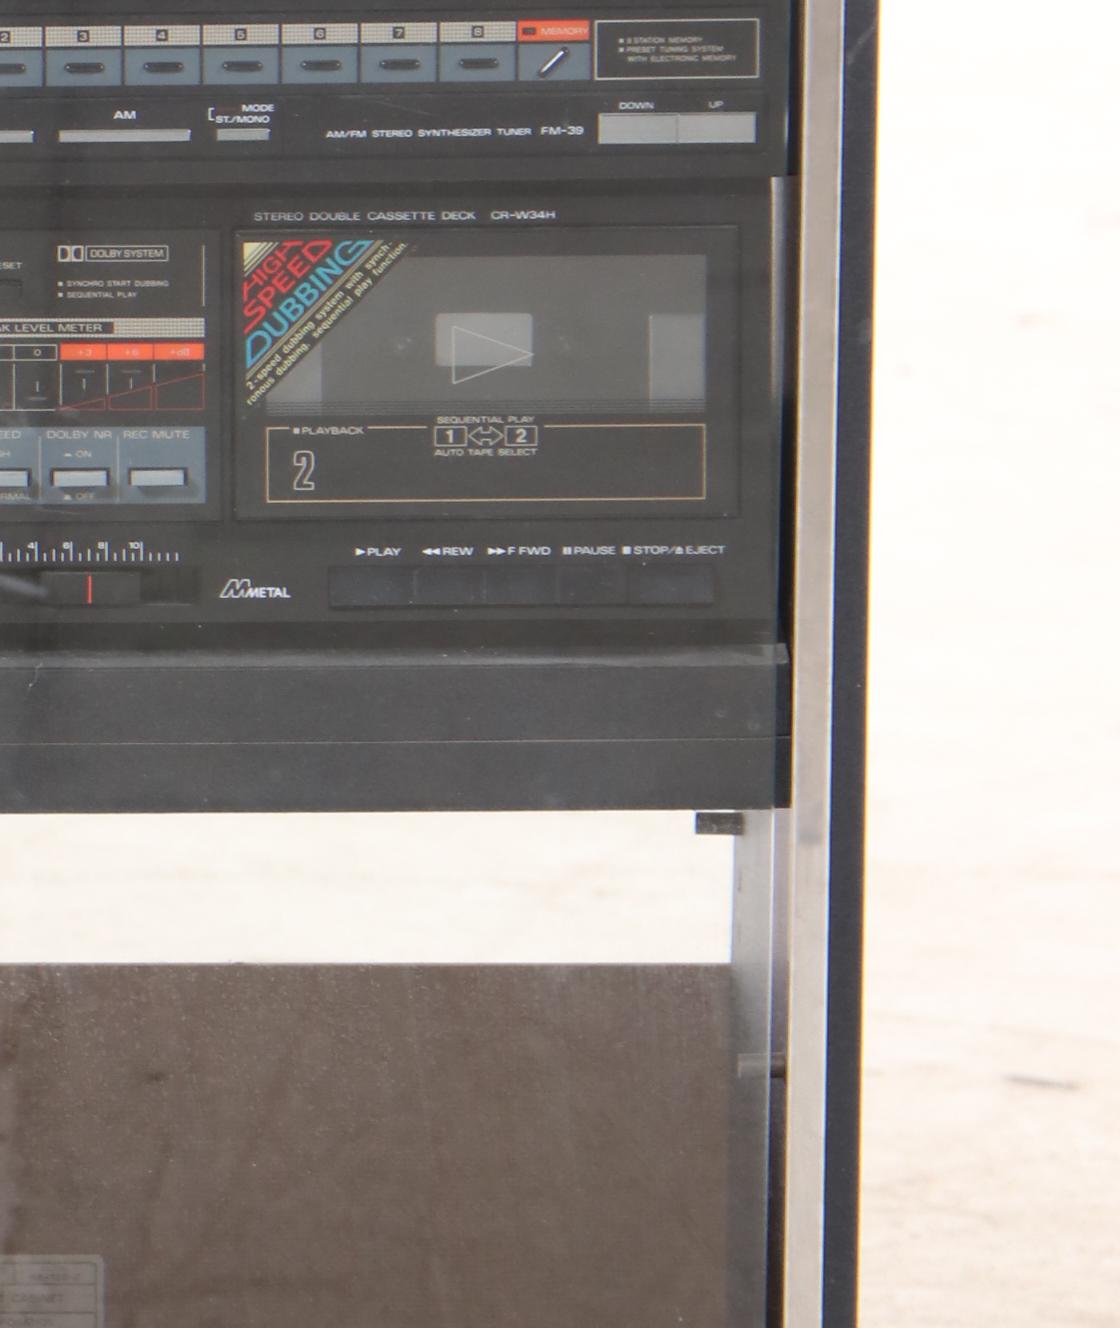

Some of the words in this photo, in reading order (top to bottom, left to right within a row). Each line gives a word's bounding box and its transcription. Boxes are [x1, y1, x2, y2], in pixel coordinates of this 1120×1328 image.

[80, 32, 87, 41] 3
[158, 31, 166, 40] 4
[237, 31, 245, 39] 5
[315, 29, 324, 38] 6
[395, 29, 404, 38] 7
[474, 28, 483, 36] 8
[1, 33, 8, 41] 2
[242, 104, 274, 112] MODE
[114, 111, 136, 119] AM
[326, 130, 367, 138] AM/FM
[418, 129, 491, 137] SYNTHESIZER
[496, 128, 531, 136] TUNER
[541, 126, 584, 135] FM-39
[254, 212, 304, 221] STEREO
[310, 212, 360, 221] DOUBLE
[367, 212, 435, 220] CASSETTE
[442, 211, 476, 220] DECK
[491, 211, 555, 219] CR-W34H
[90, 249, 122, 258] DOLBY
[124, 248, 164, 258] SYSTEM
[243, 240, 304, 302] HIGH
[243, 240, 333, 335] SPEED
[246, 240, 374, 369] DUBBING
[15, 324, 55, 333] LEVEL
[58, 324, 102, 332] METER
[437, 416, 507, 424] SEQUENTIAL
[299, 426, 364, 435] PLAYBACK
[445, 430, 454, 443] 1
[516, 430, 526, 443] 2
[434, 446, 464, 456] AUTO
[498, 448, 537, 456] SELECT
[293, 451, 315, 491] 2
[364, 548, 401, 556] PLAY
[442, 546, 473, 556] REW
[519, 546, 551, 556] FWD
[574, 546, 616, 555] PAUSE
[686, 545, 725, 555] EJECT
